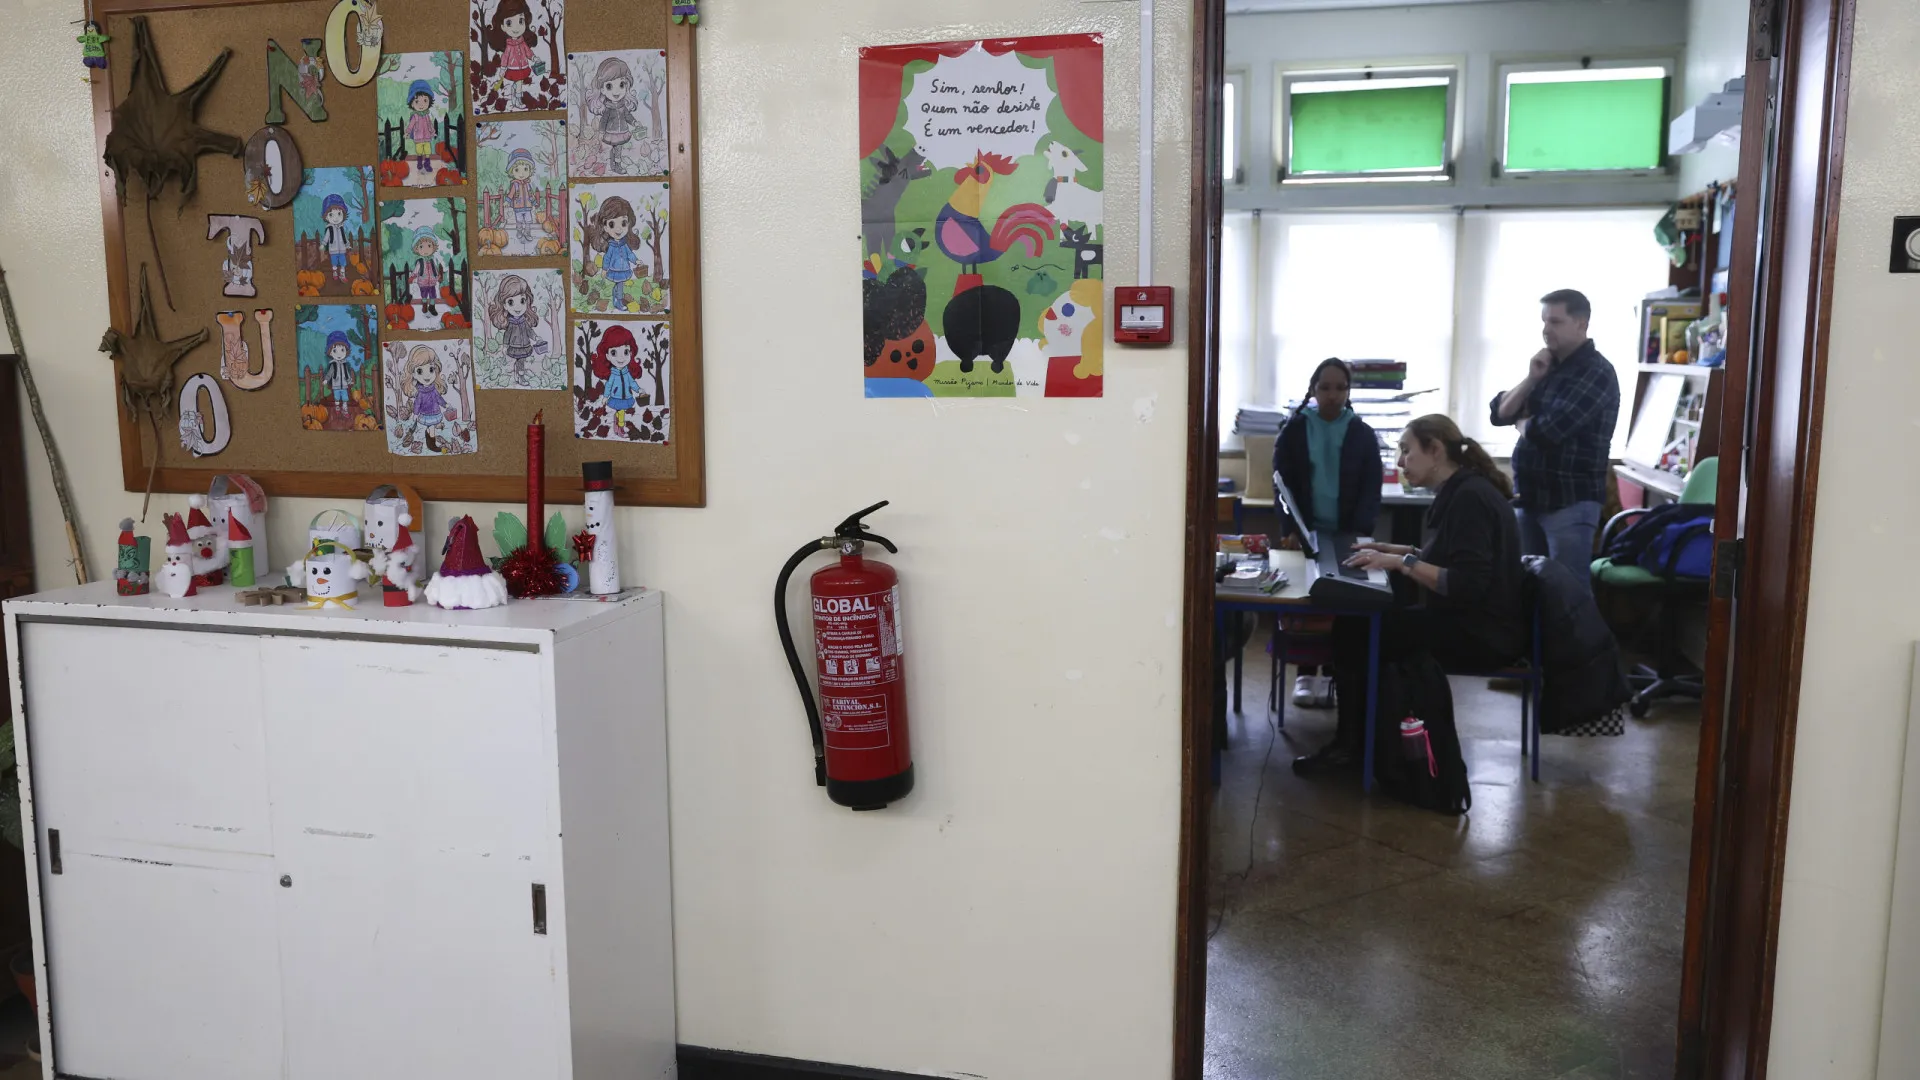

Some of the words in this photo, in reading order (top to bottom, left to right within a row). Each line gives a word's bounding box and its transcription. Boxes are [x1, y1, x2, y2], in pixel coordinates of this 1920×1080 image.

[930, 78, 966, 95] Sim,
[971, 80, 1026, 95] senhor!
[921, 102, 958, 114] Quem
[962, 100, 990, 114] não
[996, 96, 1041, 114] desiste
[923, 118, 933, 137] É
[937, 127, 962, 137] um
[966, 119, 1036, 135] vencedor!
[813, 597, 876, 613] GLOBAL
[842, 613, 877, 621] INCÊNDIOS
